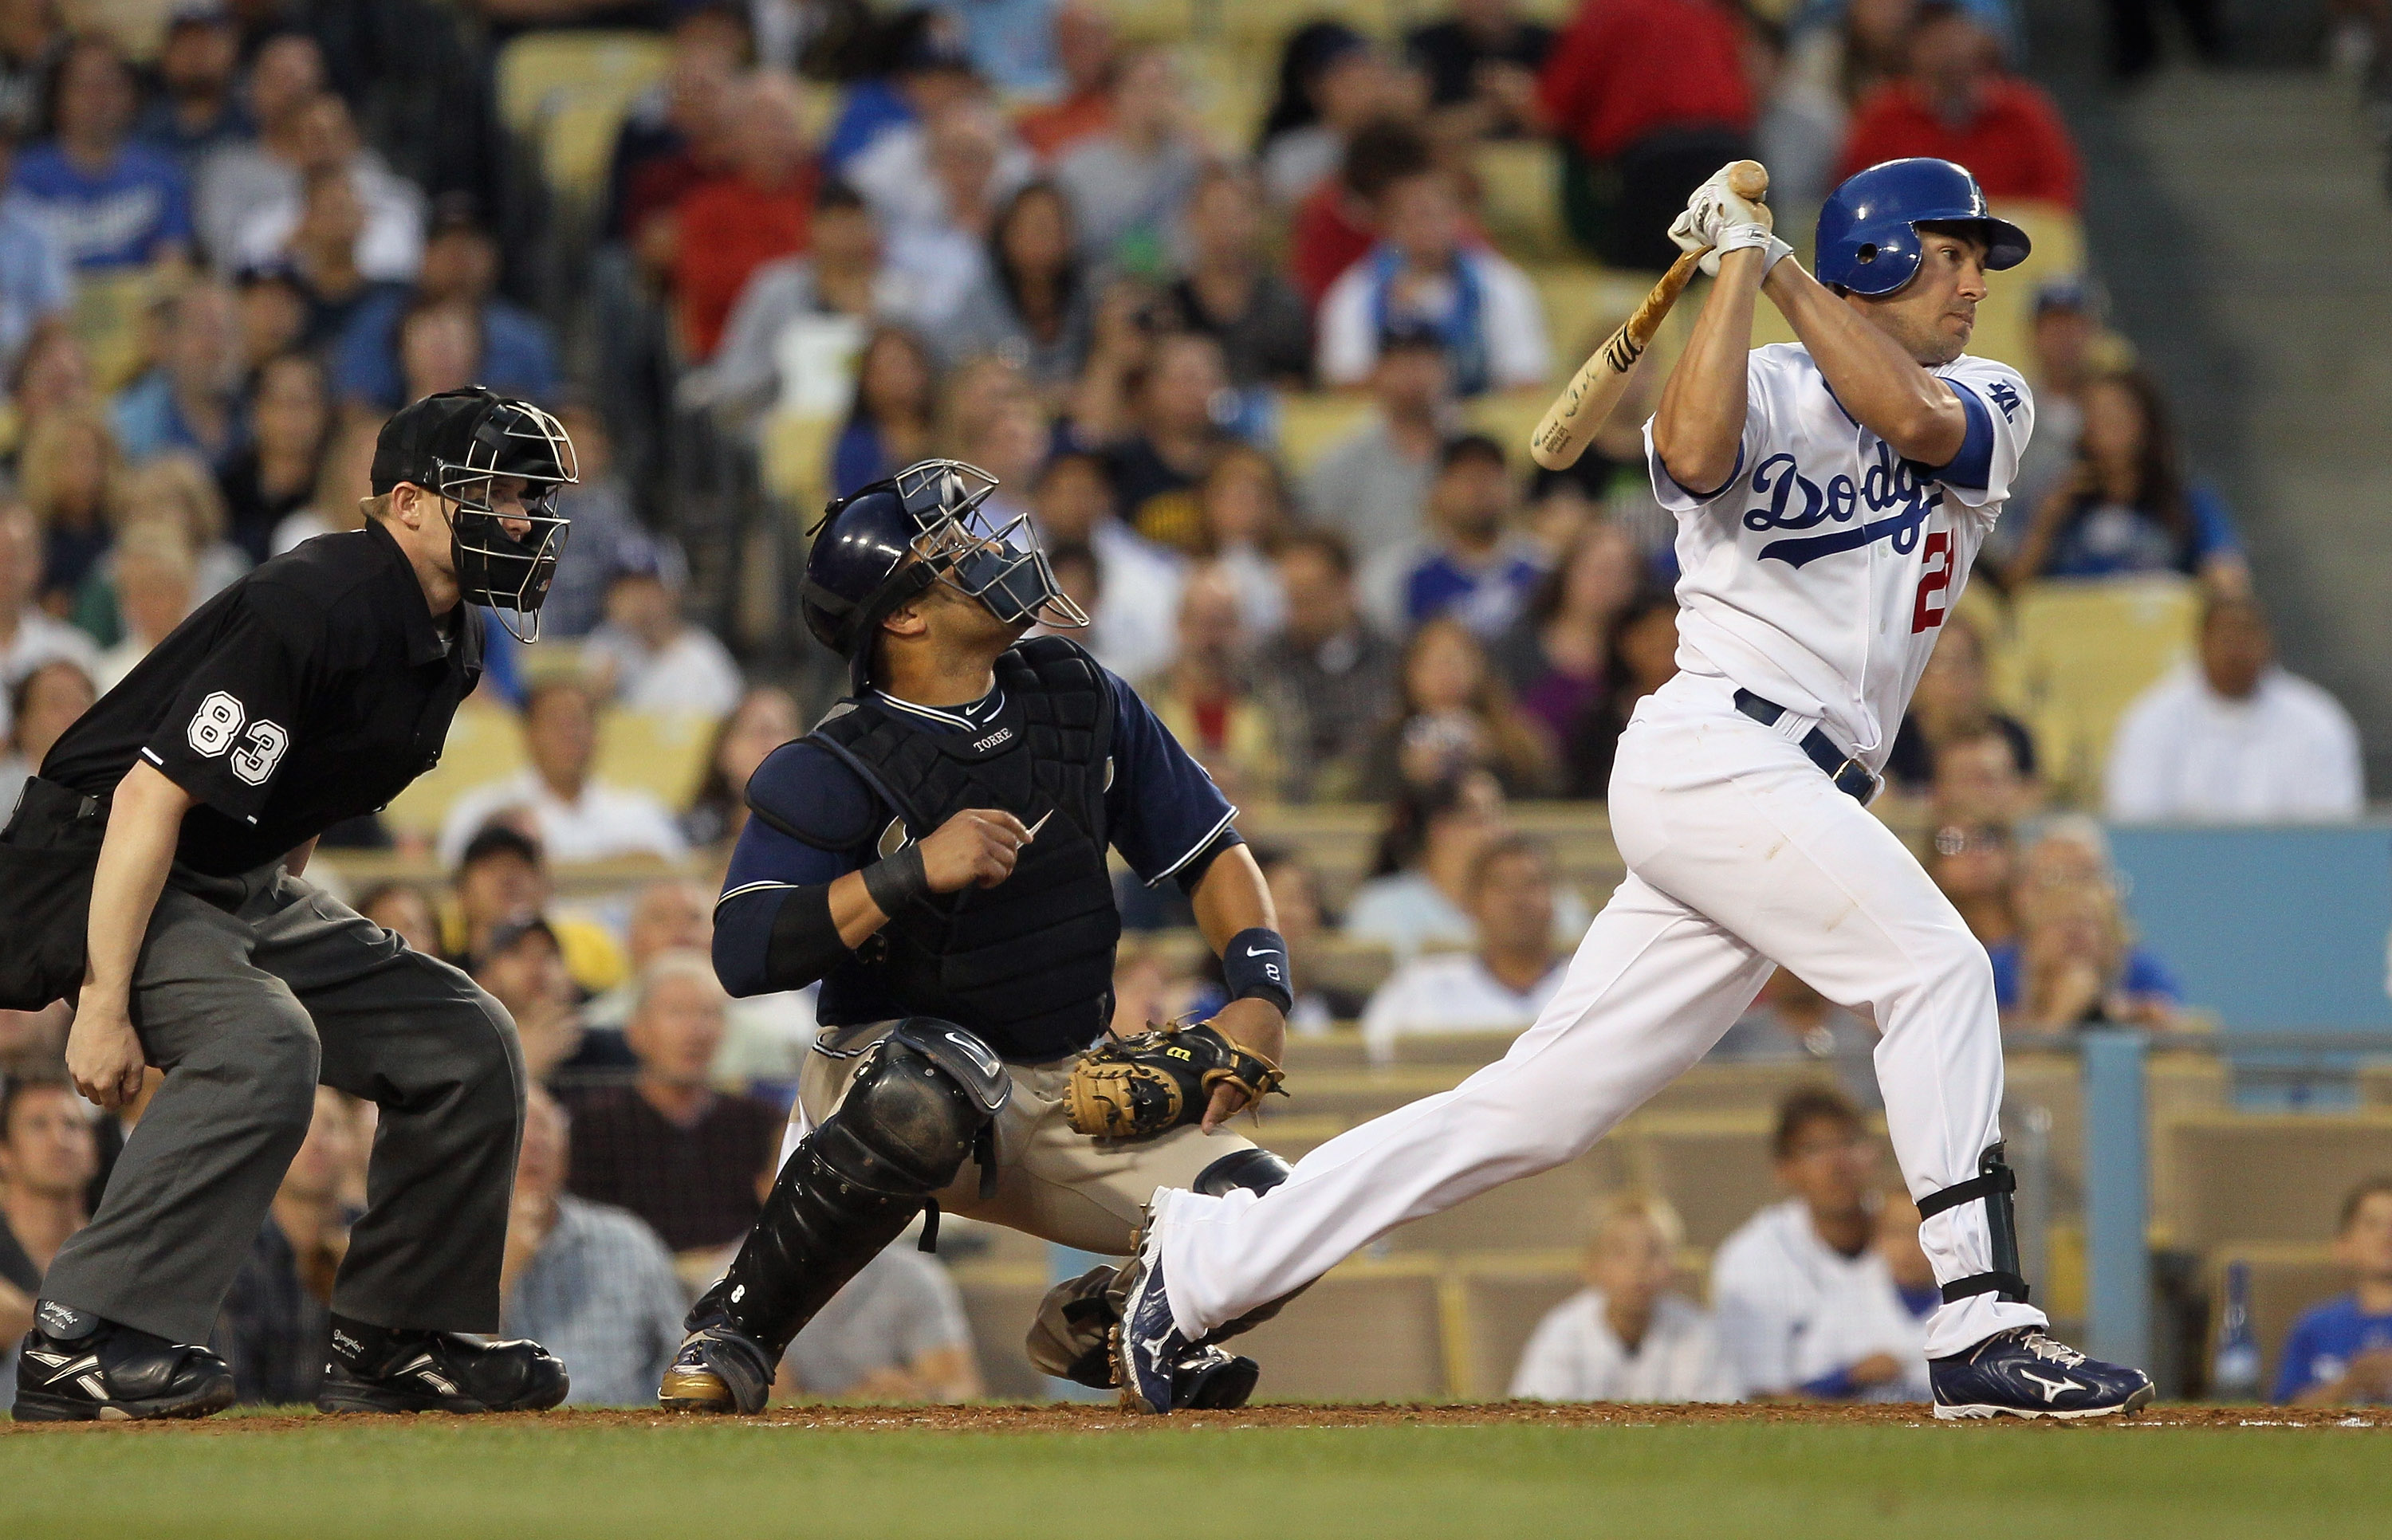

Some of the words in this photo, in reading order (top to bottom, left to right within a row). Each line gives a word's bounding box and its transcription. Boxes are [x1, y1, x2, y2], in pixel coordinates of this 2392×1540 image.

[1742, 440, 1934, 556] Dodg
[1911, 527, 1954, 634] 2
[187, 690, 289, 787] 83
[973, 727, 1013, 752] TORRE
[1265, 962, 1281, 982] 8
[730, 1284, 746, 1303] 8
